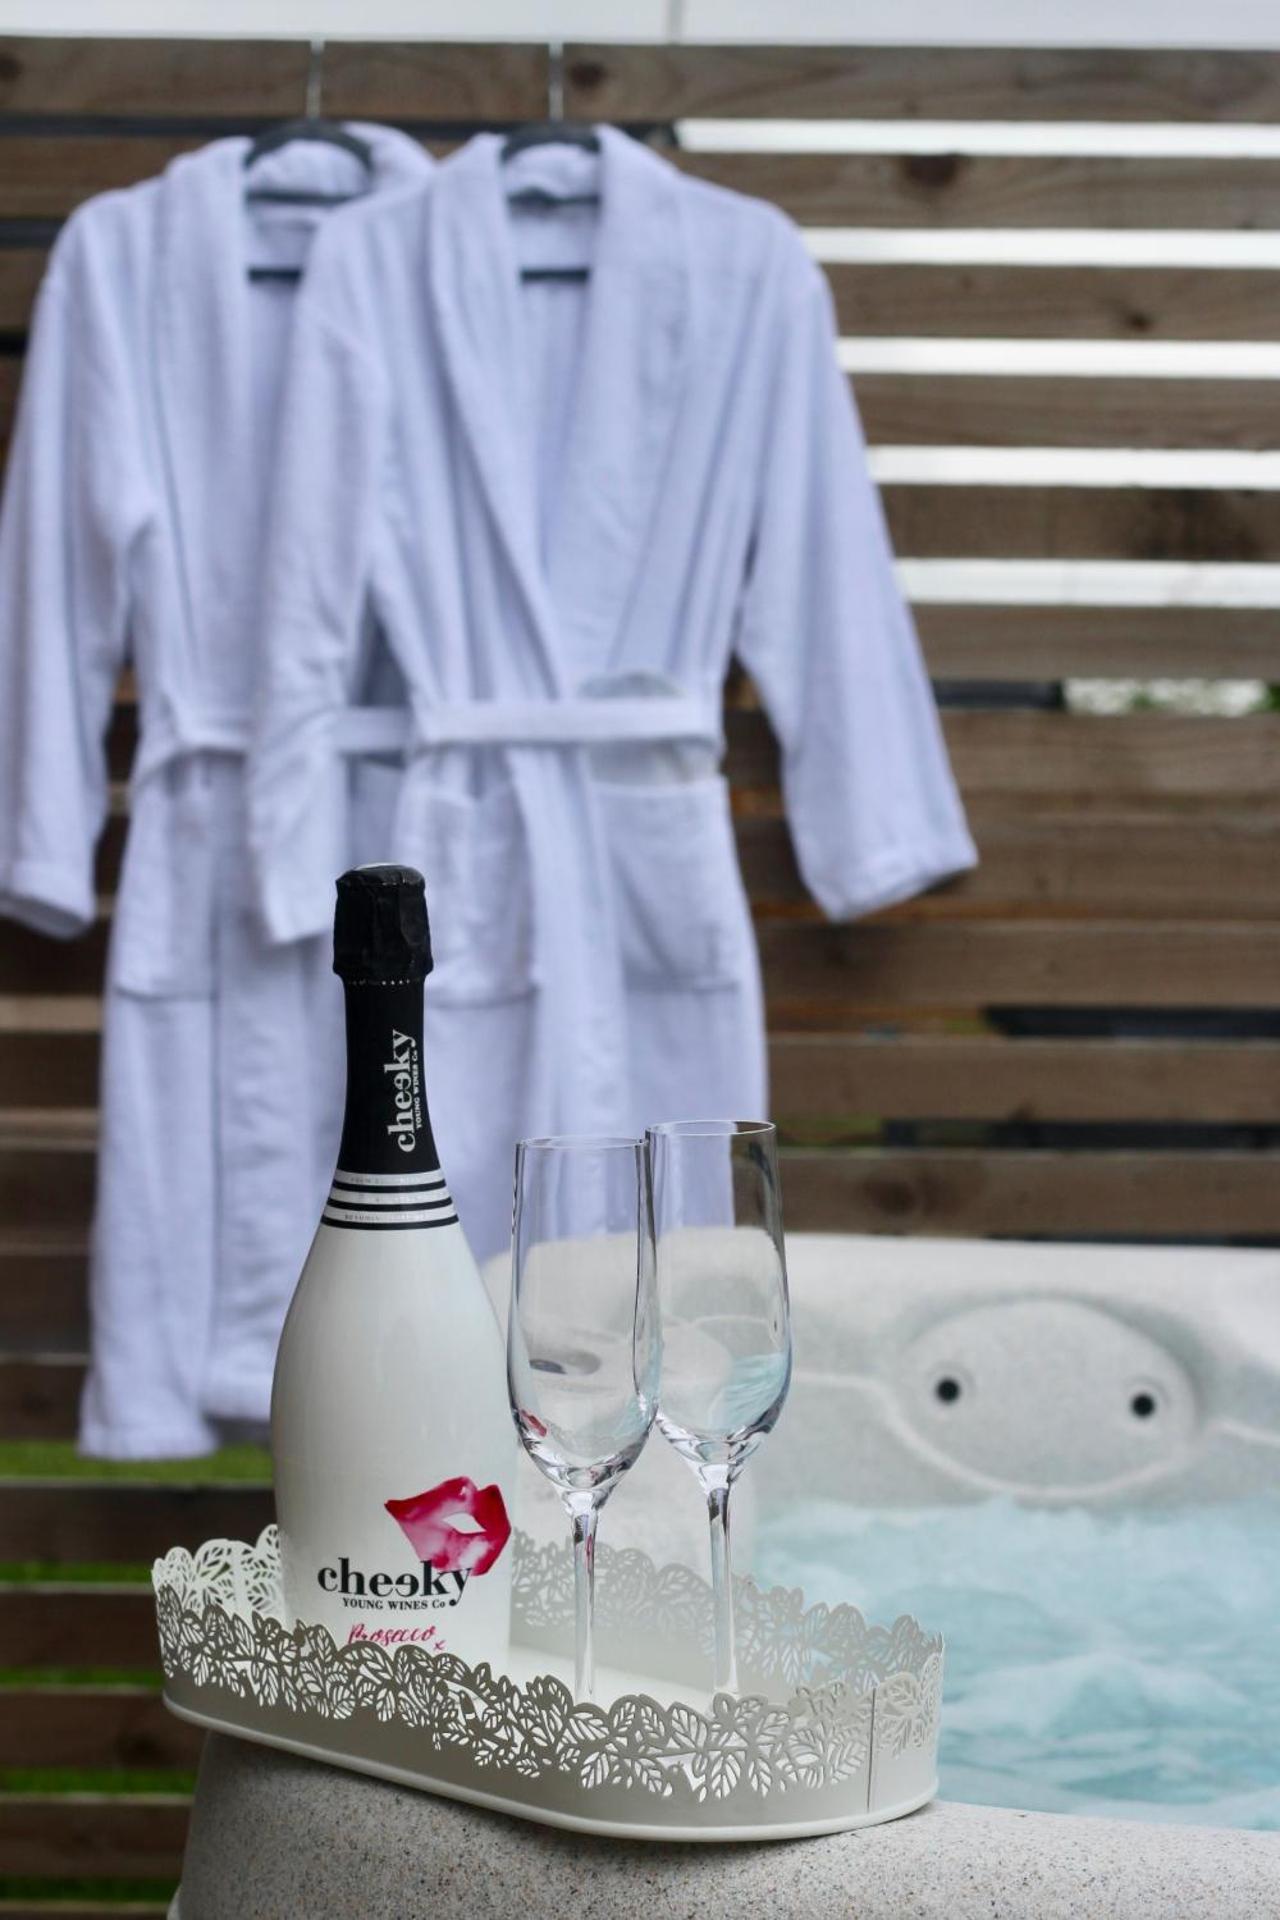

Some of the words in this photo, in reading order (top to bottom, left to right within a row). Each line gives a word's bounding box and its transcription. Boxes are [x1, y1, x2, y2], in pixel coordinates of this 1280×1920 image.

[384, 1029, 416, 1152] cheeky
[414, 1097, 422, 1129] YOUNG
[317, 1557, 473, 1606] cheeky
[342, 1597, 384, 1610] YOUNG
[388, 1600, 428, 1610] WINES
